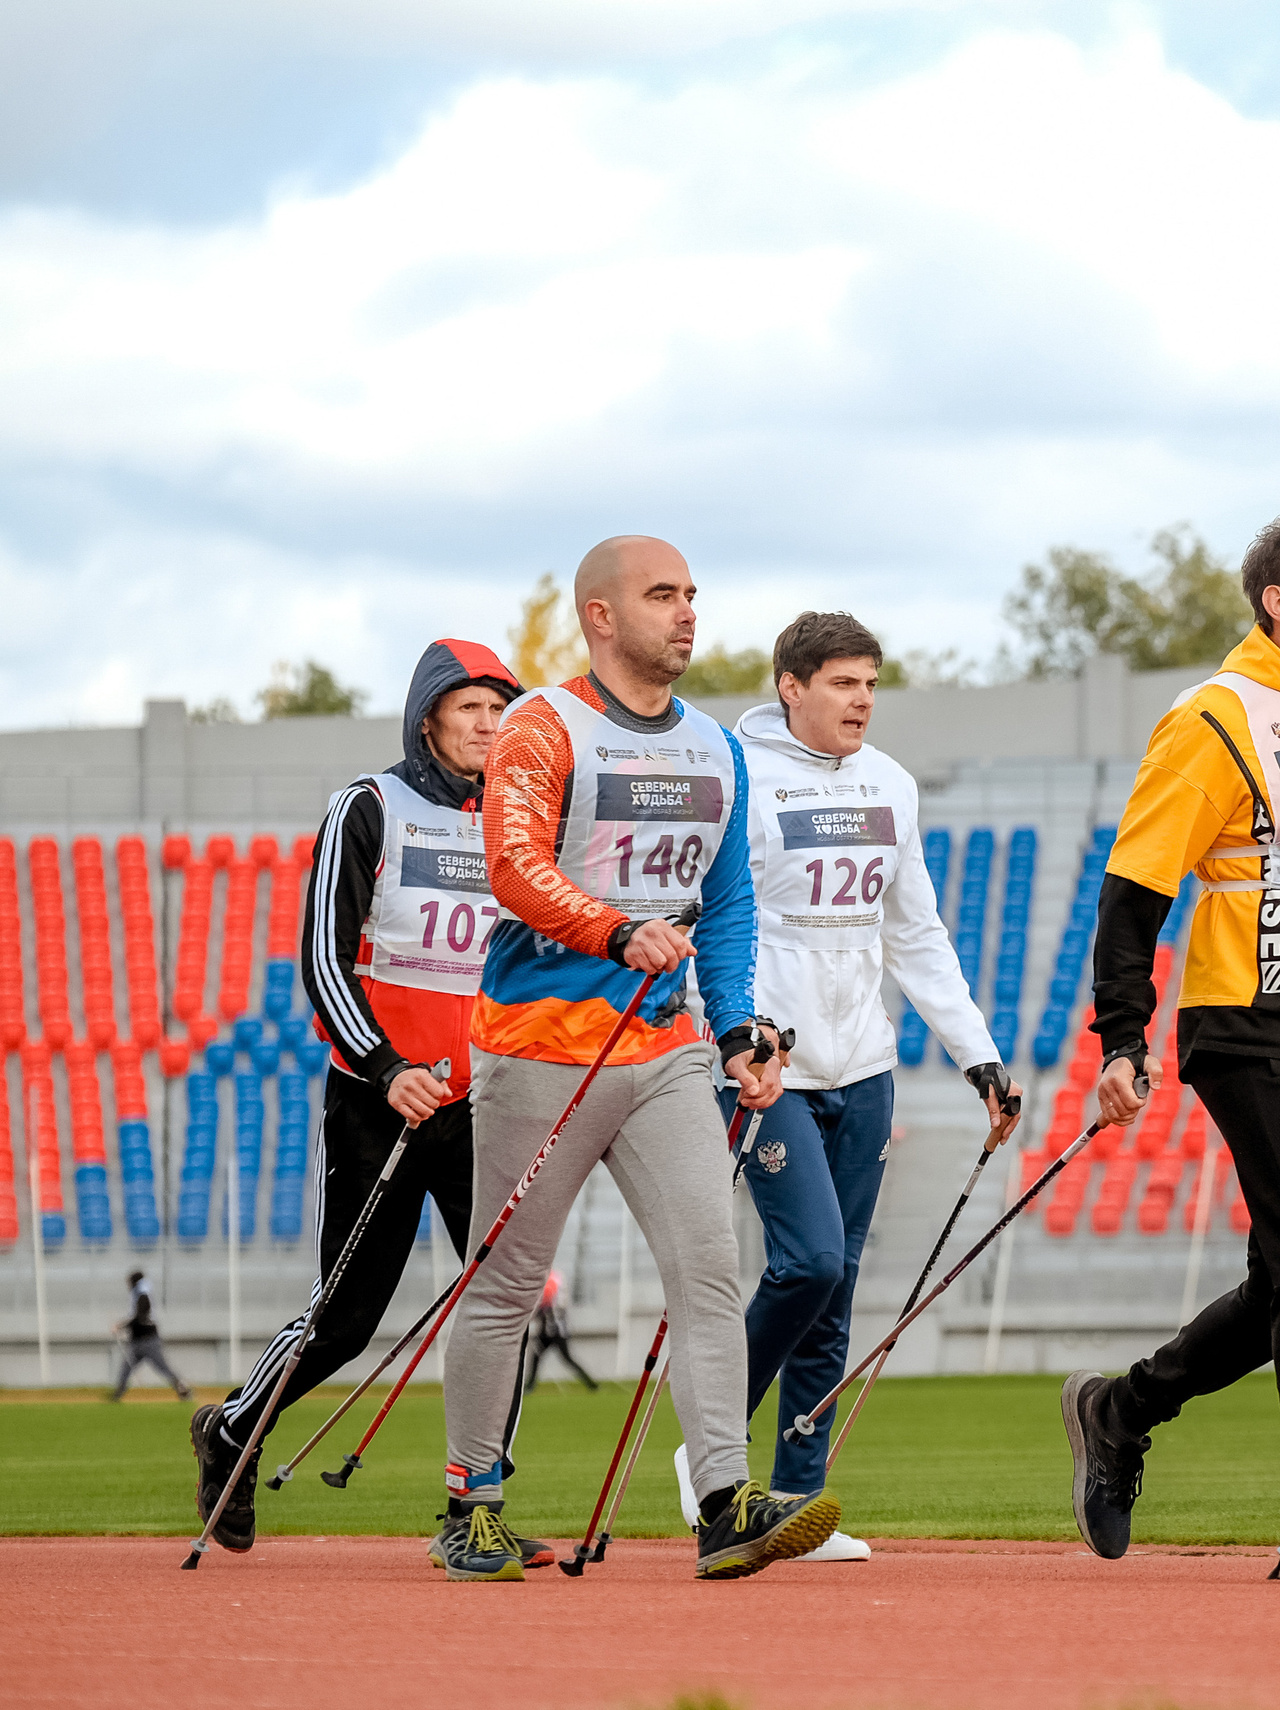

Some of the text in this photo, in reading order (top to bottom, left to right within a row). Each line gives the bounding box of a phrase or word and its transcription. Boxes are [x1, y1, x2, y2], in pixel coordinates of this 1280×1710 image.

[630, 781, 690, 794] СЕВЕРНАЯ
[811, 812, 865, 825] СЕВЕРНАЯ
[437, 854, 488, 869] СЕВЕРНА
[615, 834, 703, 888] 140
[806, 856, 884, 906] 126
[420, 900, 499, 954] 107
